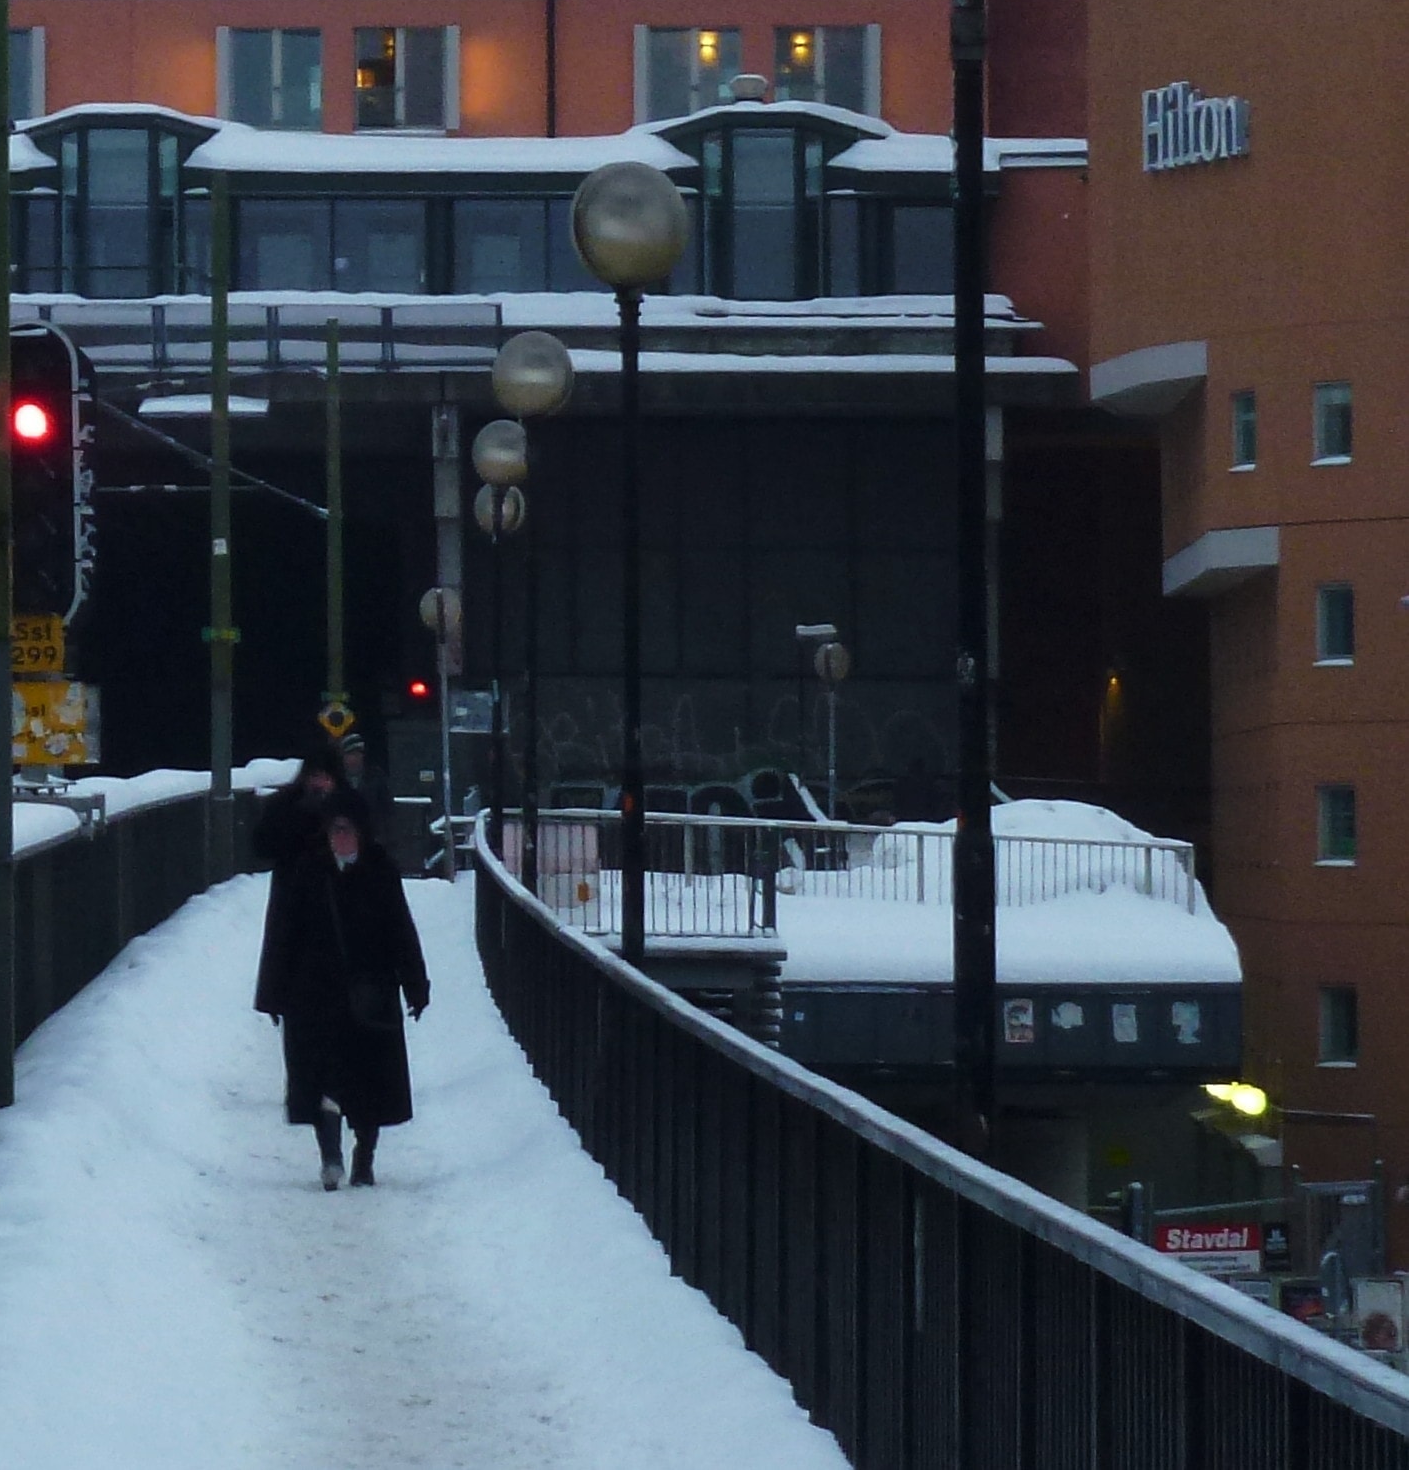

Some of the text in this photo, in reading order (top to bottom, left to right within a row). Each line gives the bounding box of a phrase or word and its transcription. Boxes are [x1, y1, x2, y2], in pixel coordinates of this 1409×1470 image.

[1142, 81, 1250, 169] Hilton
[11, 645, 56, 666] 299
[1165, 1226, 1248, 1249] Stavdal
